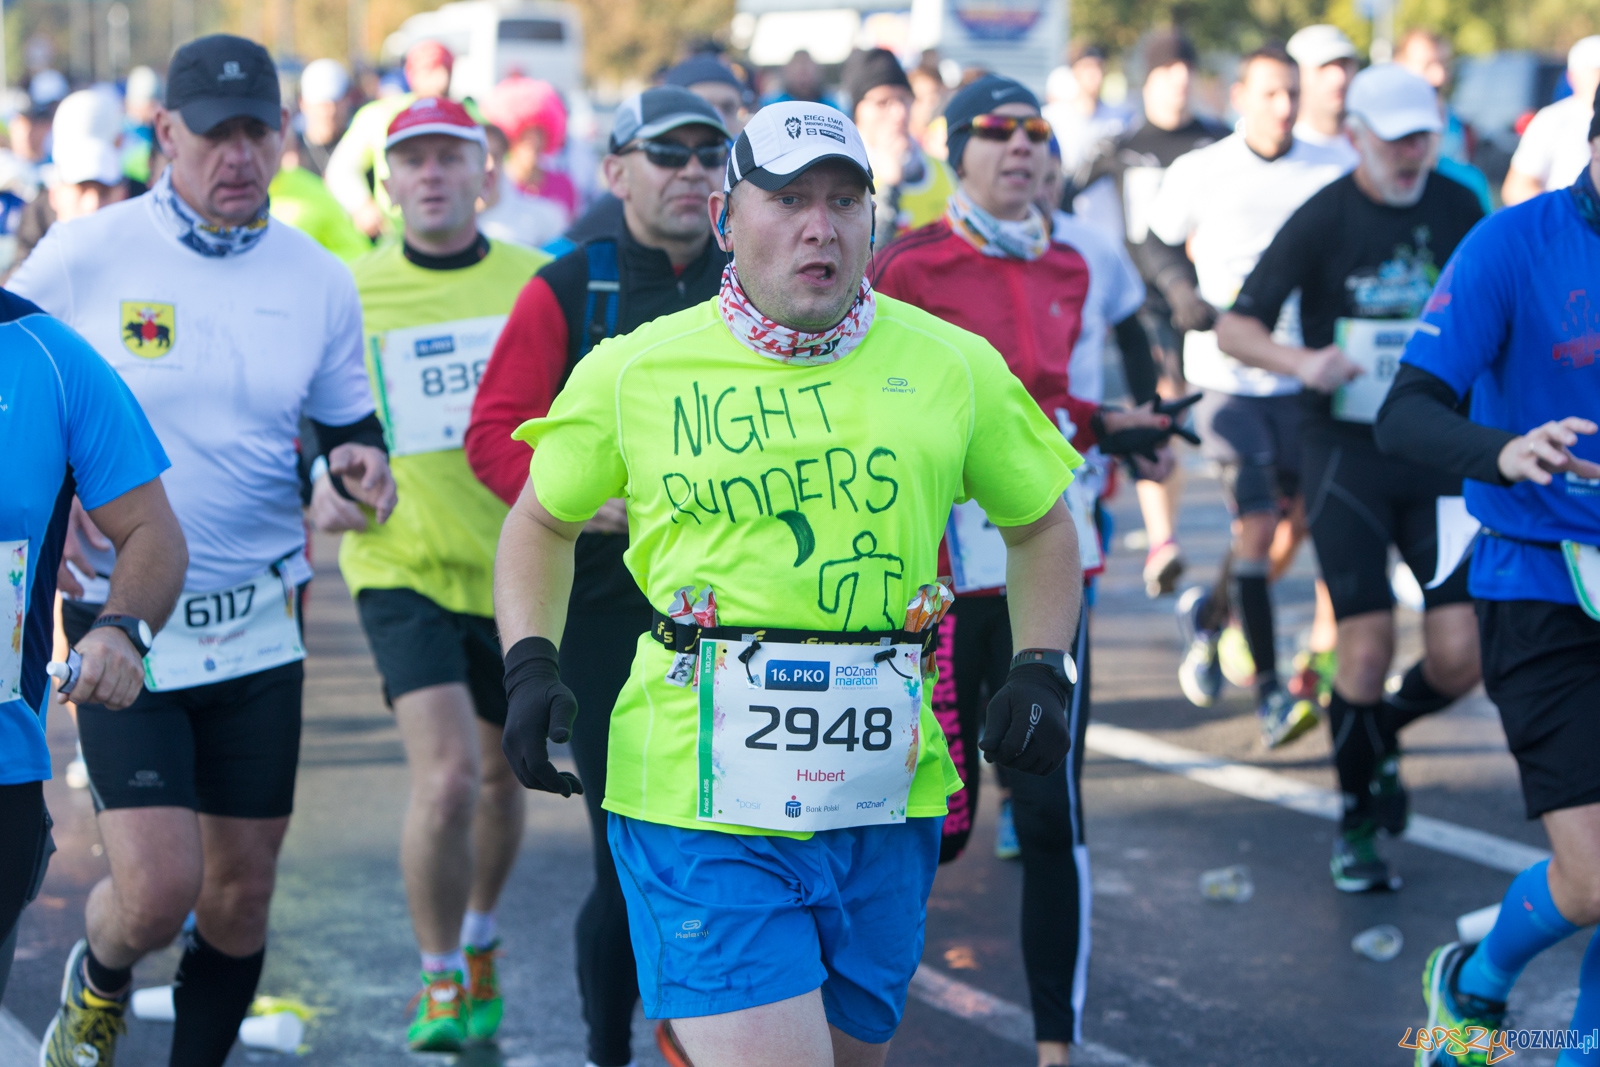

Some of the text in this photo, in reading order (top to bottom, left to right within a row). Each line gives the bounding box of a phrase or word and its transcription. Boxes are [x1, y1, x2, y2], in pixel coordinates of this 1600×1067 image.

[803, 114, 844, 127] BIEG LWA
[881, 386, 917, 394] Kalenji
[673, 380, 832, 457] NIGHT
[184, 584, 256, 628] 6117
[770, 668, 825, 683] 16. PKO
[834, 676, 878, 686] maraton
[744, 704, 893, 752] 2948
[796, 768, 846, 782] Hubert
[805, 803, 840, 813] Bank Polski
